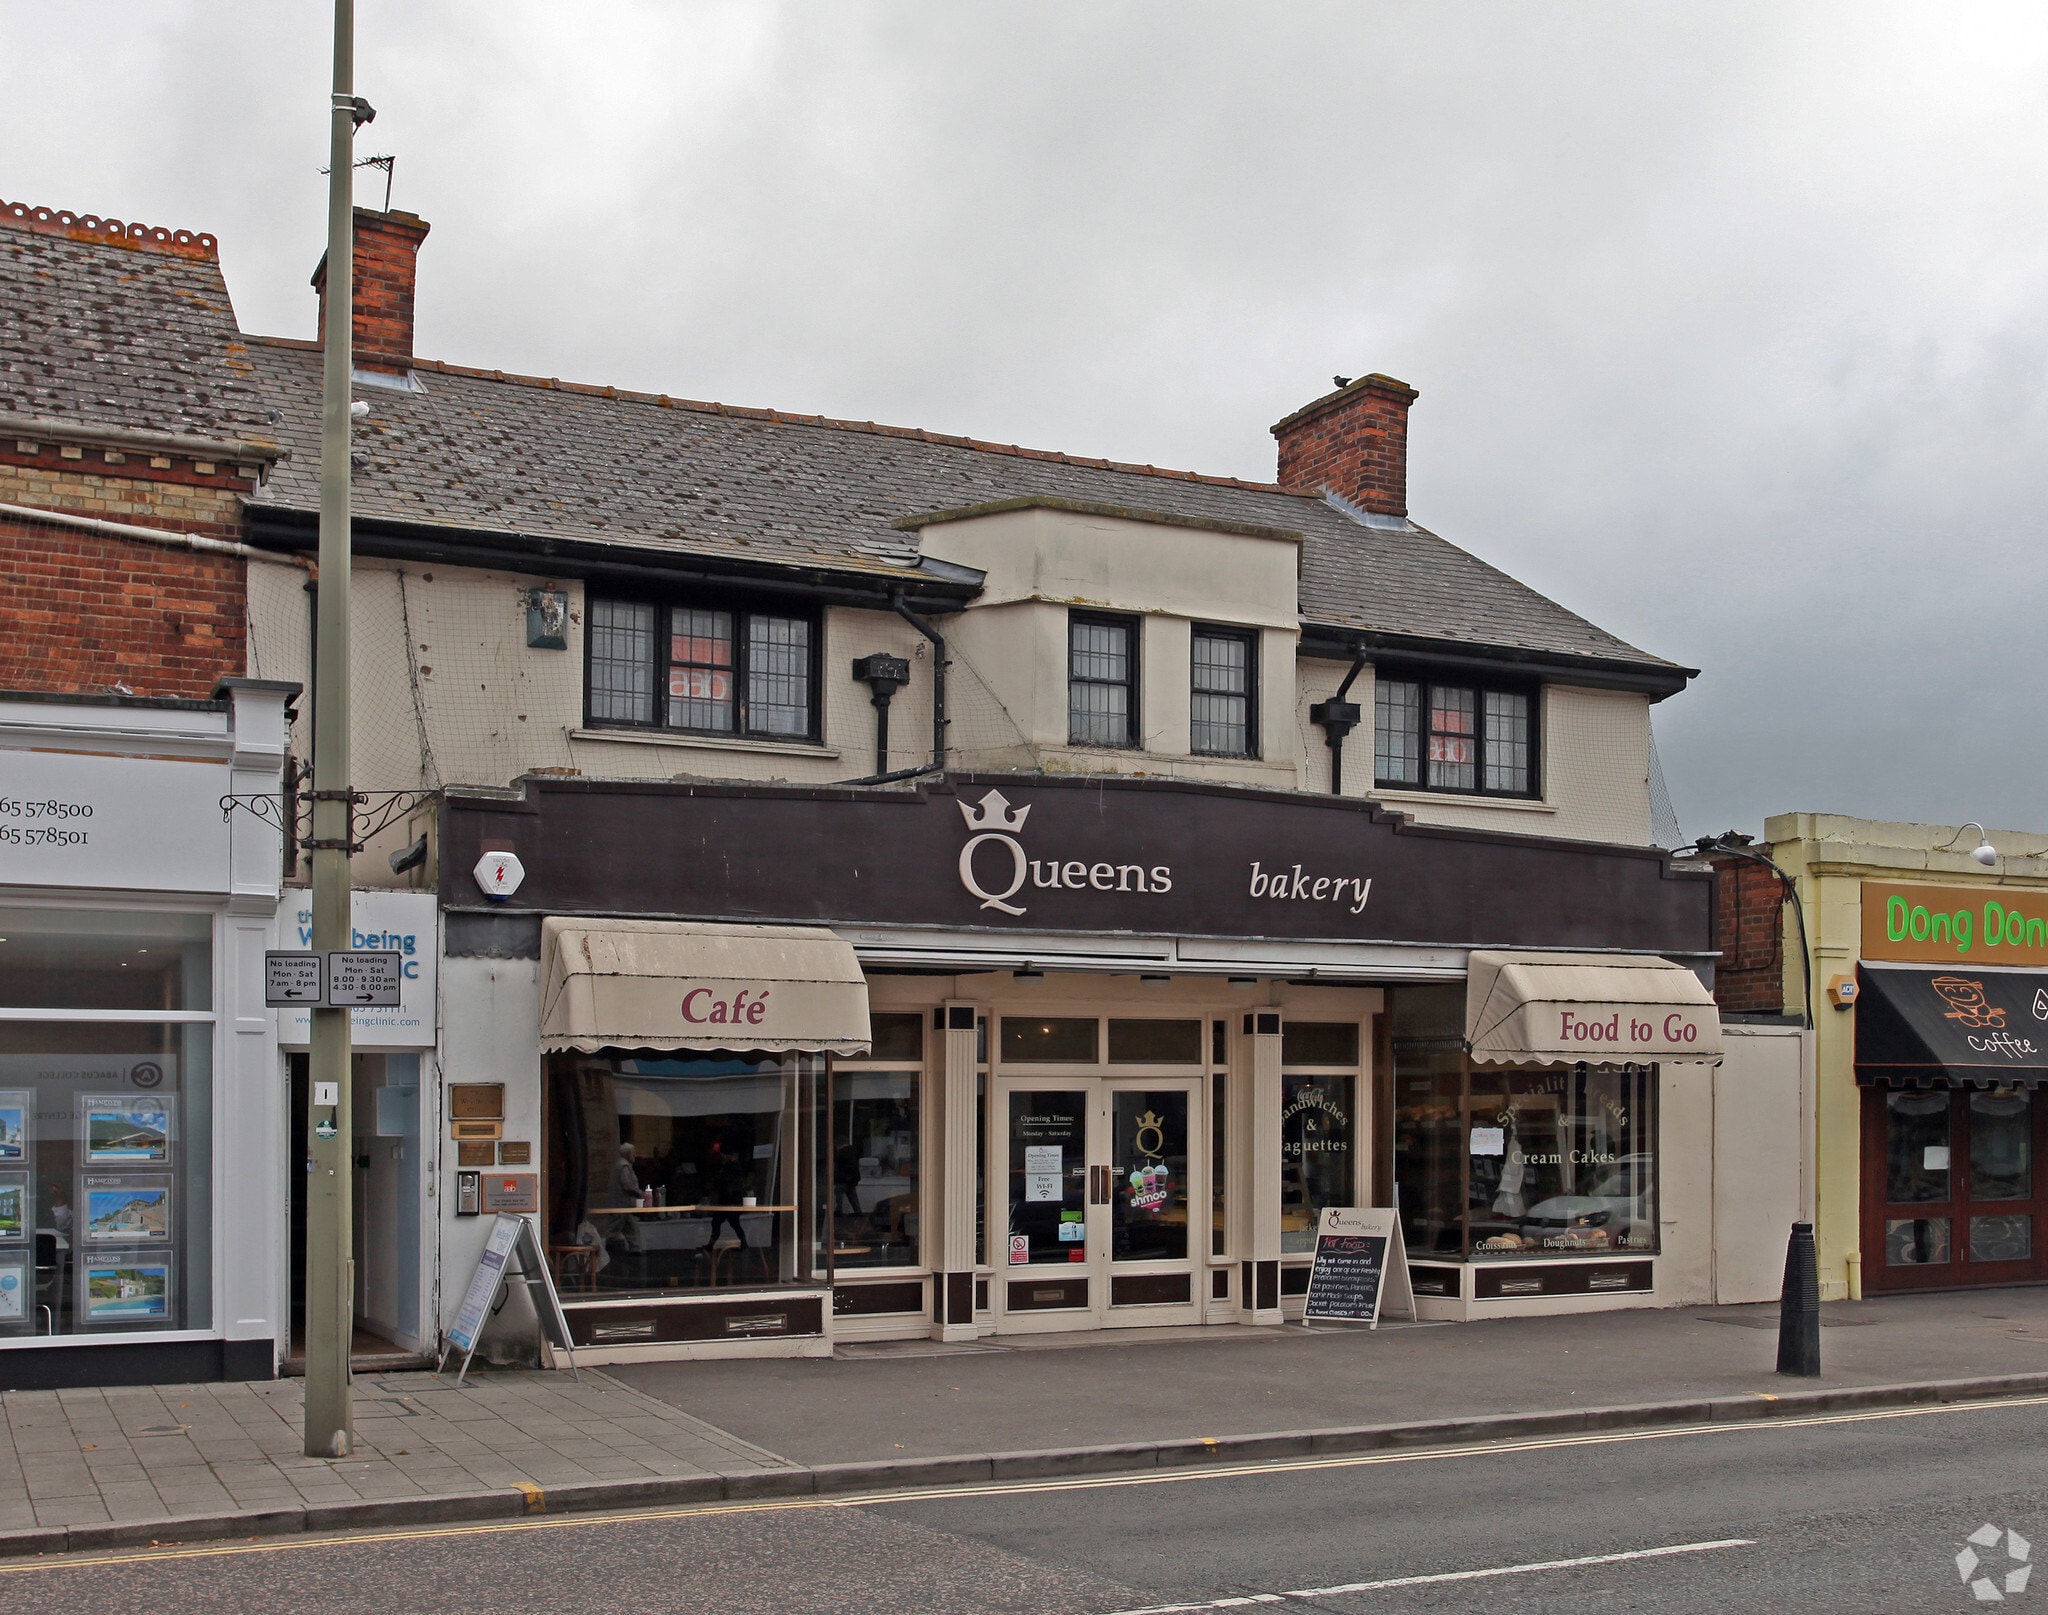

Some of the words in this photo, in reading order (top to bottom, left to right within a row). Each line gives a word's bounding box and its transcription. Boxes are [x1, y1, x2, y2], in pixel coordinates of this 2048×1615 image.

[25, 800, 93, 819] 578500
[25, 827, 88, 846] 578501
[959, 833, 1172, 916] Queens
[1249, 861, 1372, 915] bakery
[1984, 901, 2048, 948] Don
[285, 960, 316, 968] loading
[1841, 985, 1854, 994] ADT
[681, 988, 770, 1025] Café
[1560, 1012, 1619, 1042] Food
[1630, 1017, 1653, 1042] to
[1663, 1013, 1698, 1043] Go
[1020, 1115, 1051, 1123] Opening
[1282, 1098, 1348, 1126] andwiches
[1306, 1118, 1317, 1131] &
[1558, 1114, 1569, 1127] &
[1282, 1140, 1347, 1155] aguettes
[1511, 1150, 1562, 1165] Cream
[1569, 1149, 1615, 1164] Cakes
[1130, 1190, 1168, 1208] shmoo
[1328, 1215, 1361, 1229] Queens
[1543, 1238, 1586, 1249] Doughnuts
[1617, 1235, 1647, 1245] Pastries
